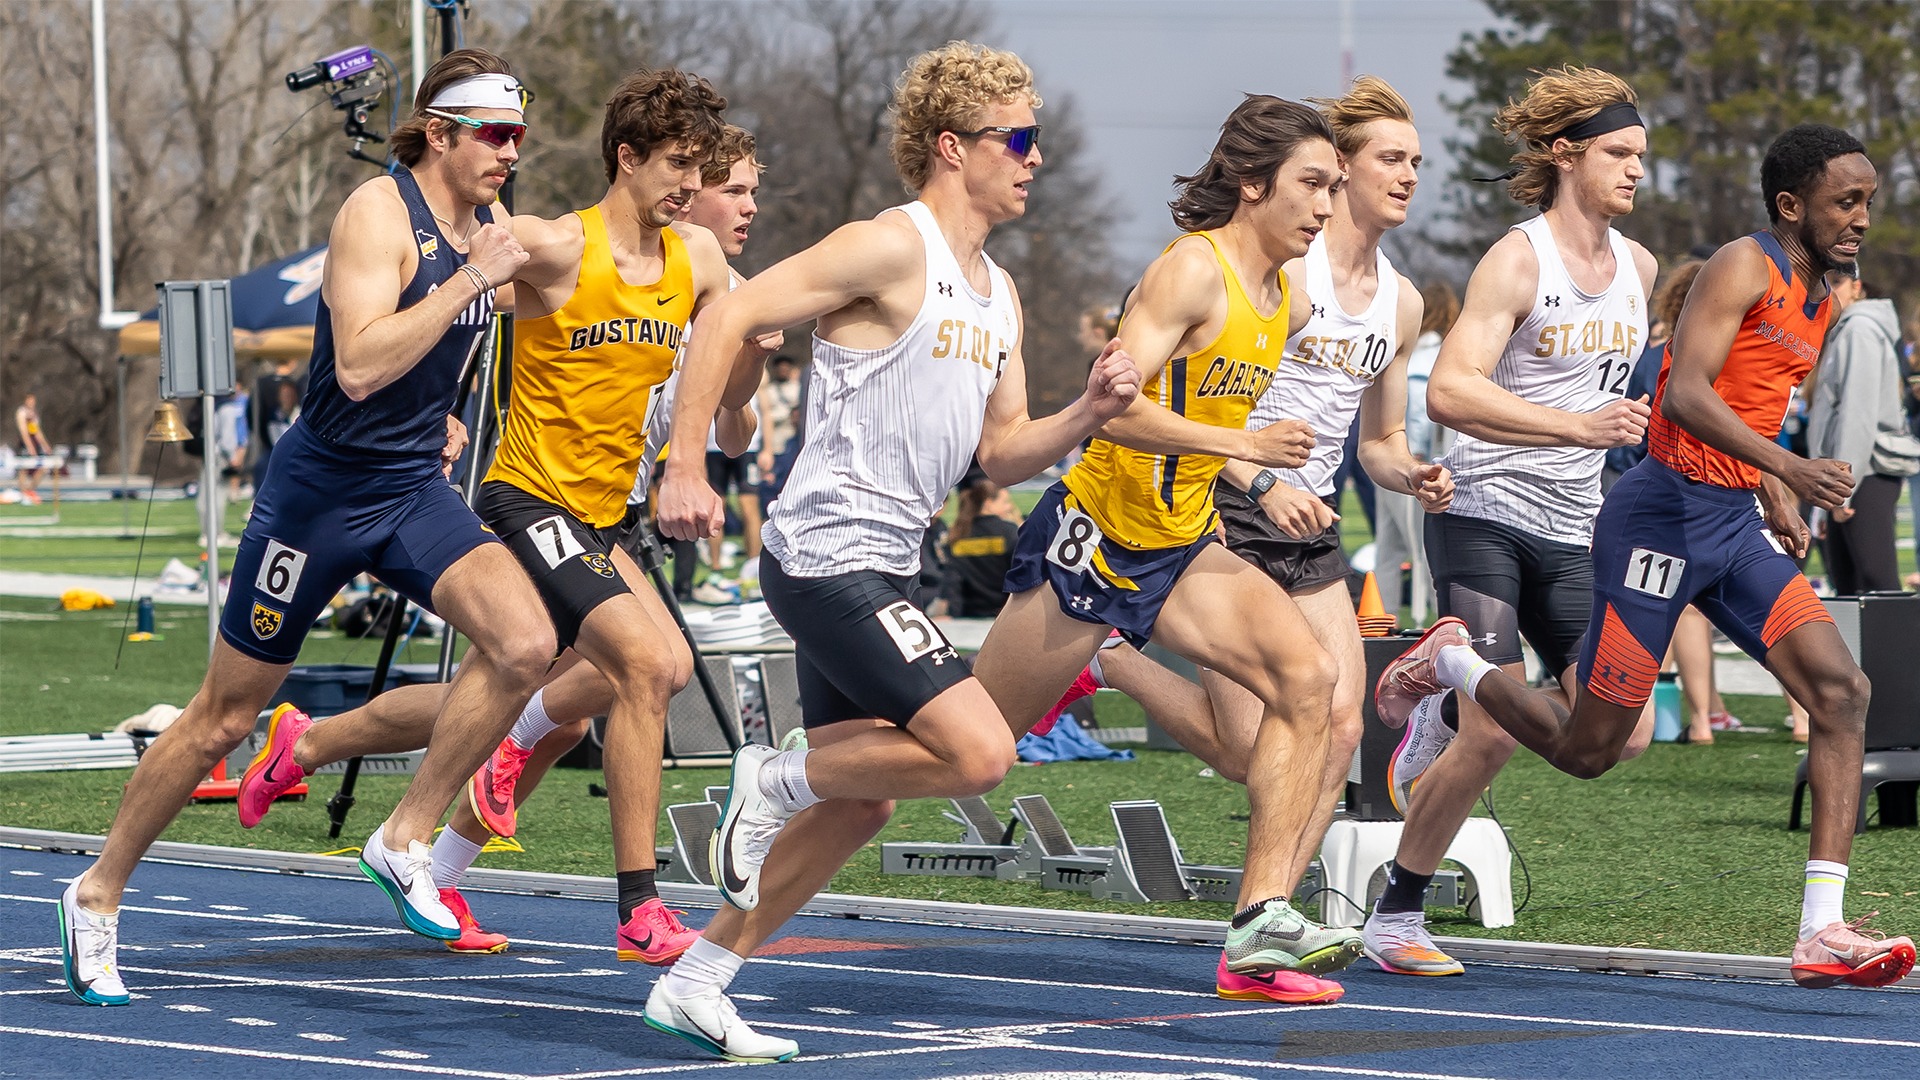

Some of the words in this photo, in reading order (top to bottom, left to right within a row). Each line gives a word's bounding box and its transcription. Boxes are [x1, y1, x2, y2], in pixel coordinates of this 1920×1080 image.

[1360, 332, 1388, 374] 10
[1534, 324, 1577, 358] ST.
[1581, 319, 1638, 359] OLAF
[1597, 358, 1631, 396] 12
[534, 519, 567, 561] 7
[1057, 516, 1094, 568] 8
[266, 549, 297, 595] 6
[1639, 552, 1673, 595] 11
[888, 603, 932, 653] 5
[1403, 716, 1428, 764] balance
